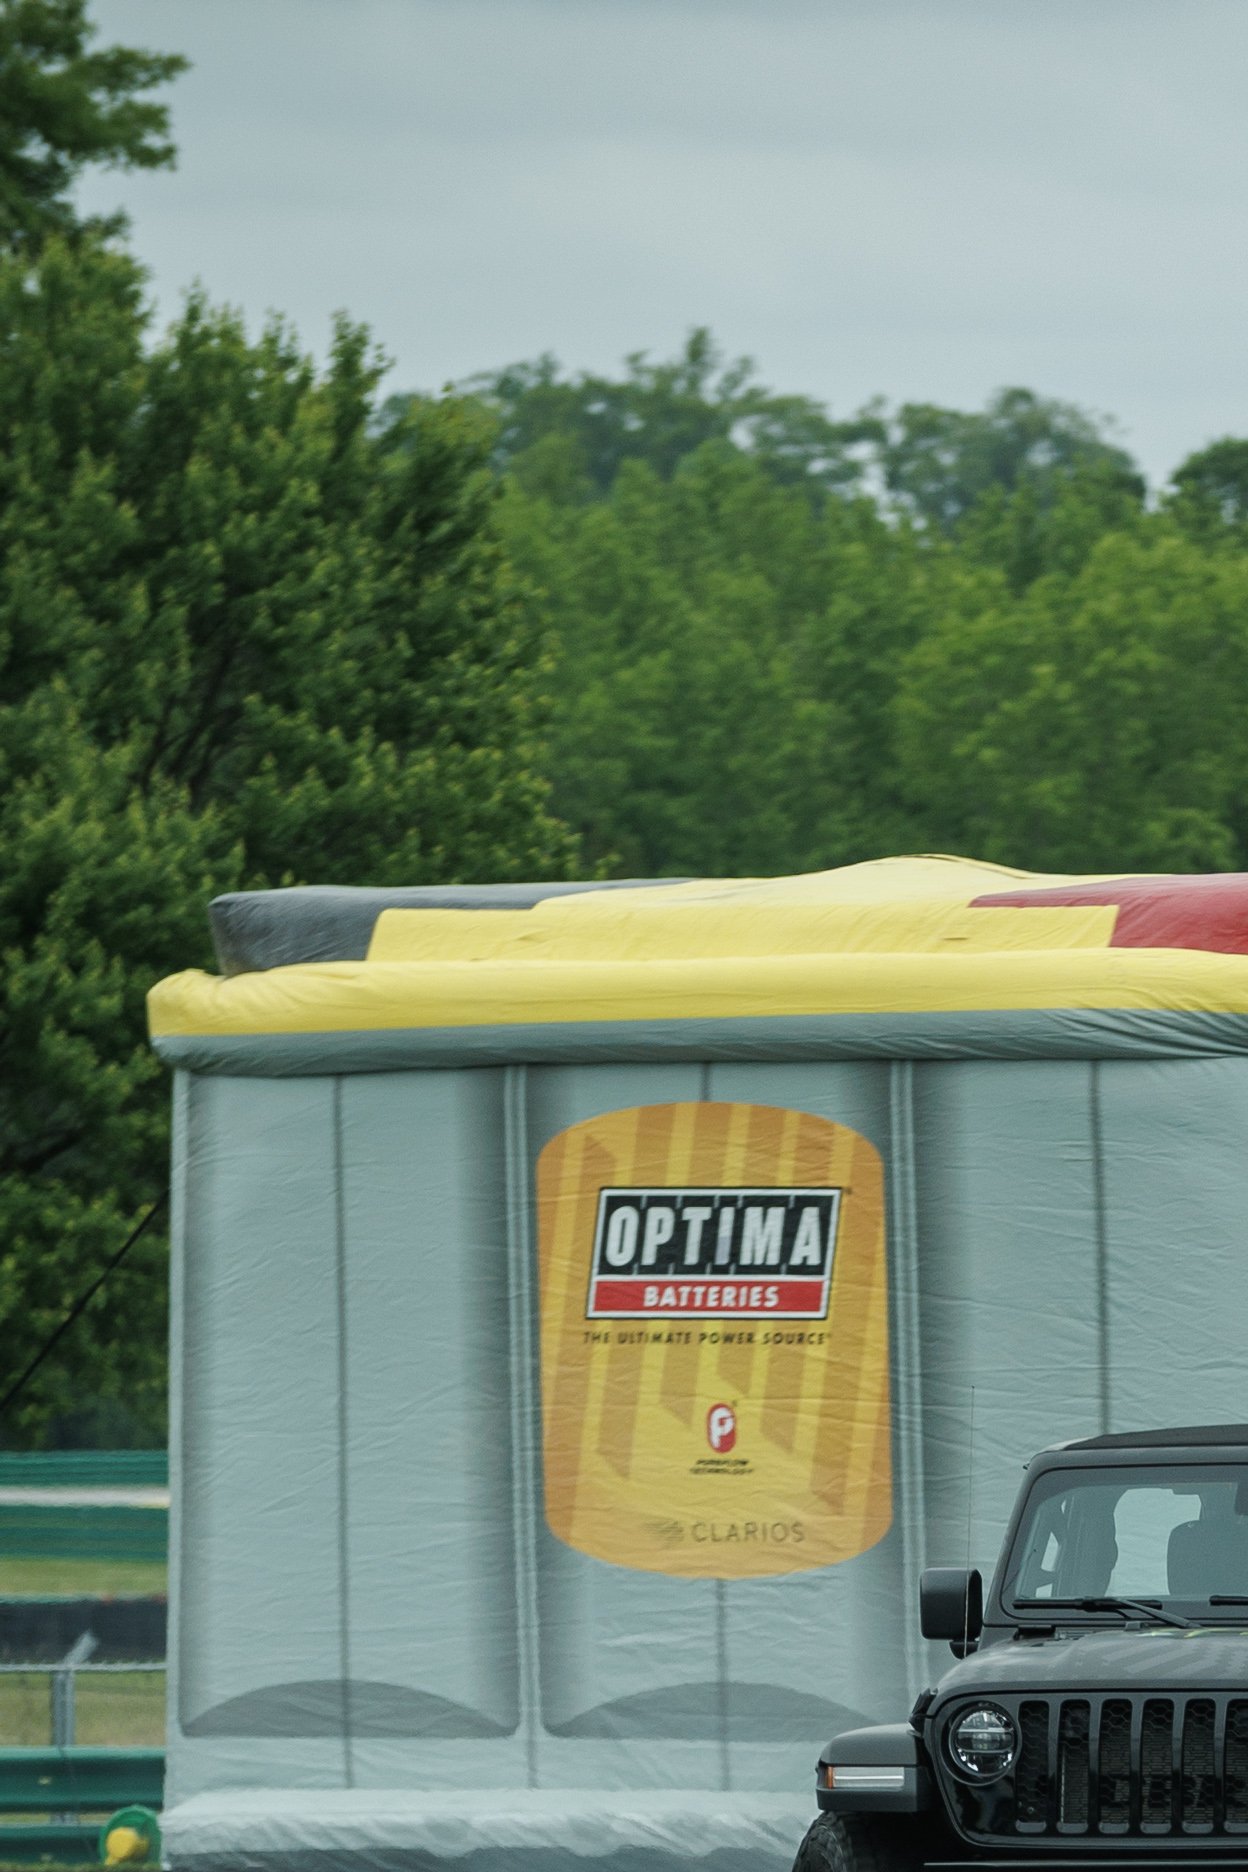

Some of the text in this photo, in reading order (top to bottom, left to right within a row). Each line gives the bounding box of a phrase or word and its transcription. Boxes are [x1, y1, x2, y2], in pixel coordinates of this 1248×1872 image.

[605, 1205, 822, 1267] OPTIMA
[643, 1285, 780, 1308] BATTERIES
[583, 1331, 825, 1345] THE ULTIMATE POWER SOURCE
[691, 1520, 805, 1543] CLARIOS
